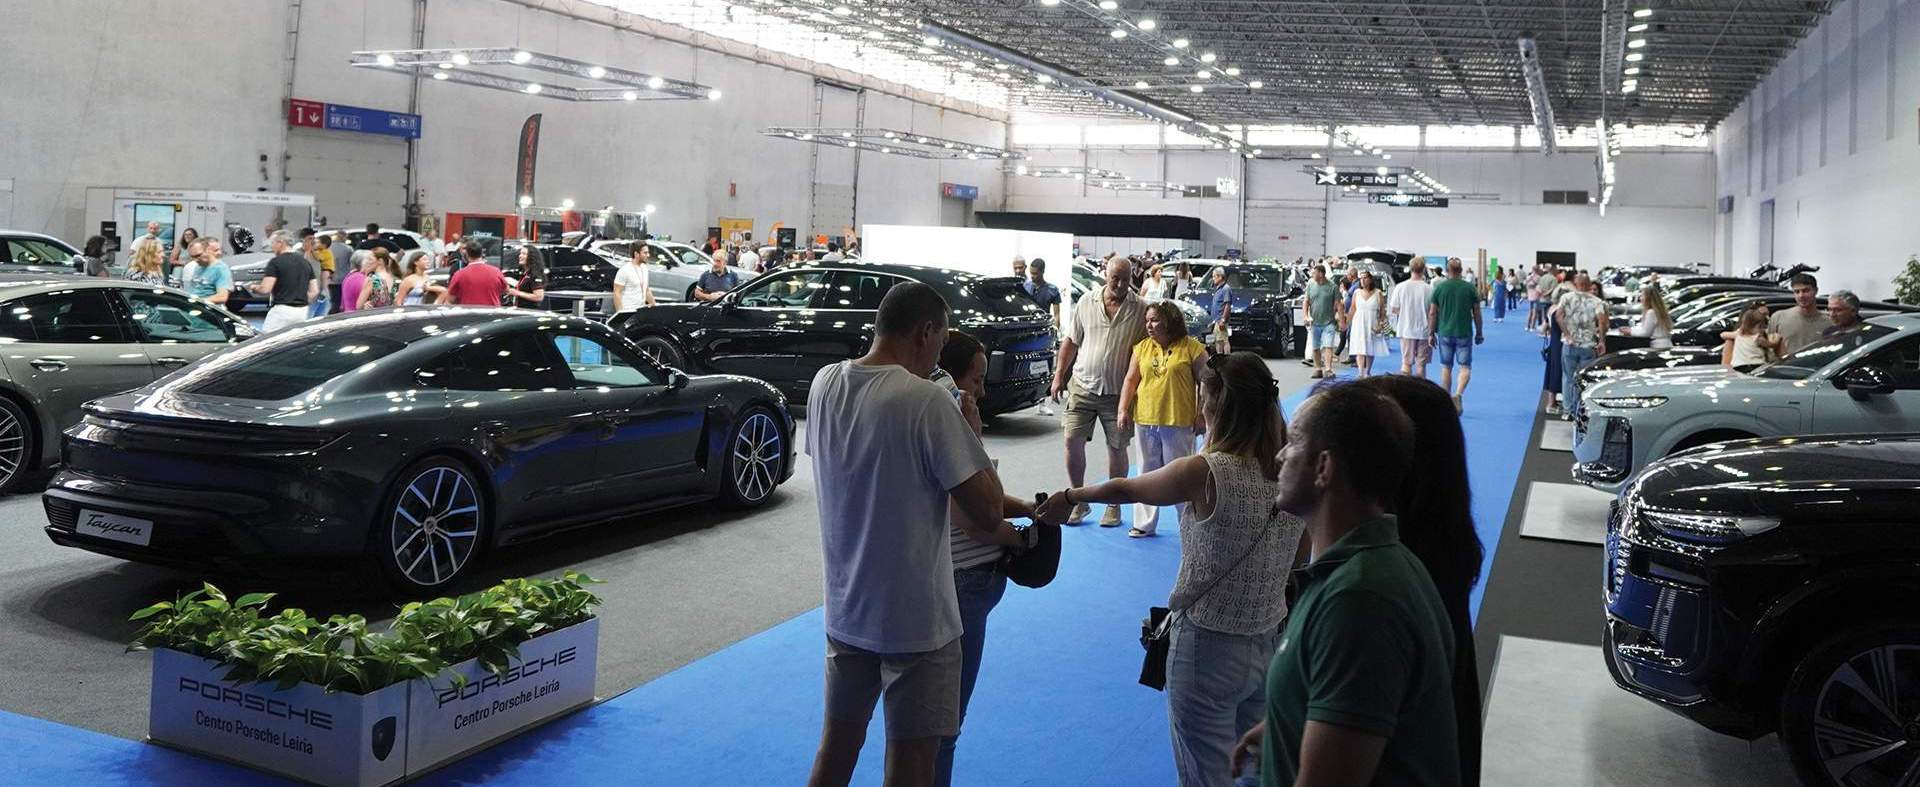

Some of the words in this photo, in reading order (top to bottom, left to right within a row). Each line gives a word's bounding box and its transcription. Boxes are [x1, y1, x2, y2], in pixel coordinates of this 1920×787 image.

[296, 107, 303, 124] 1
[1340, 175, 1397, 184] XPENG
[86, 514, 142, 536] Taycan
[438, 646, 576, 709] PORSCHE
[180, 676, 333, 730] PORSCHE
[454, 707, 489, 730] Centro
[492, 691, 532, 715] Porsche
[534, 679, 560, 702] Leiria
[196, 710, 232, 732] Centro
[236, 721, 280, 746] Porsche
[282, 734, 313, 755] Leiria
